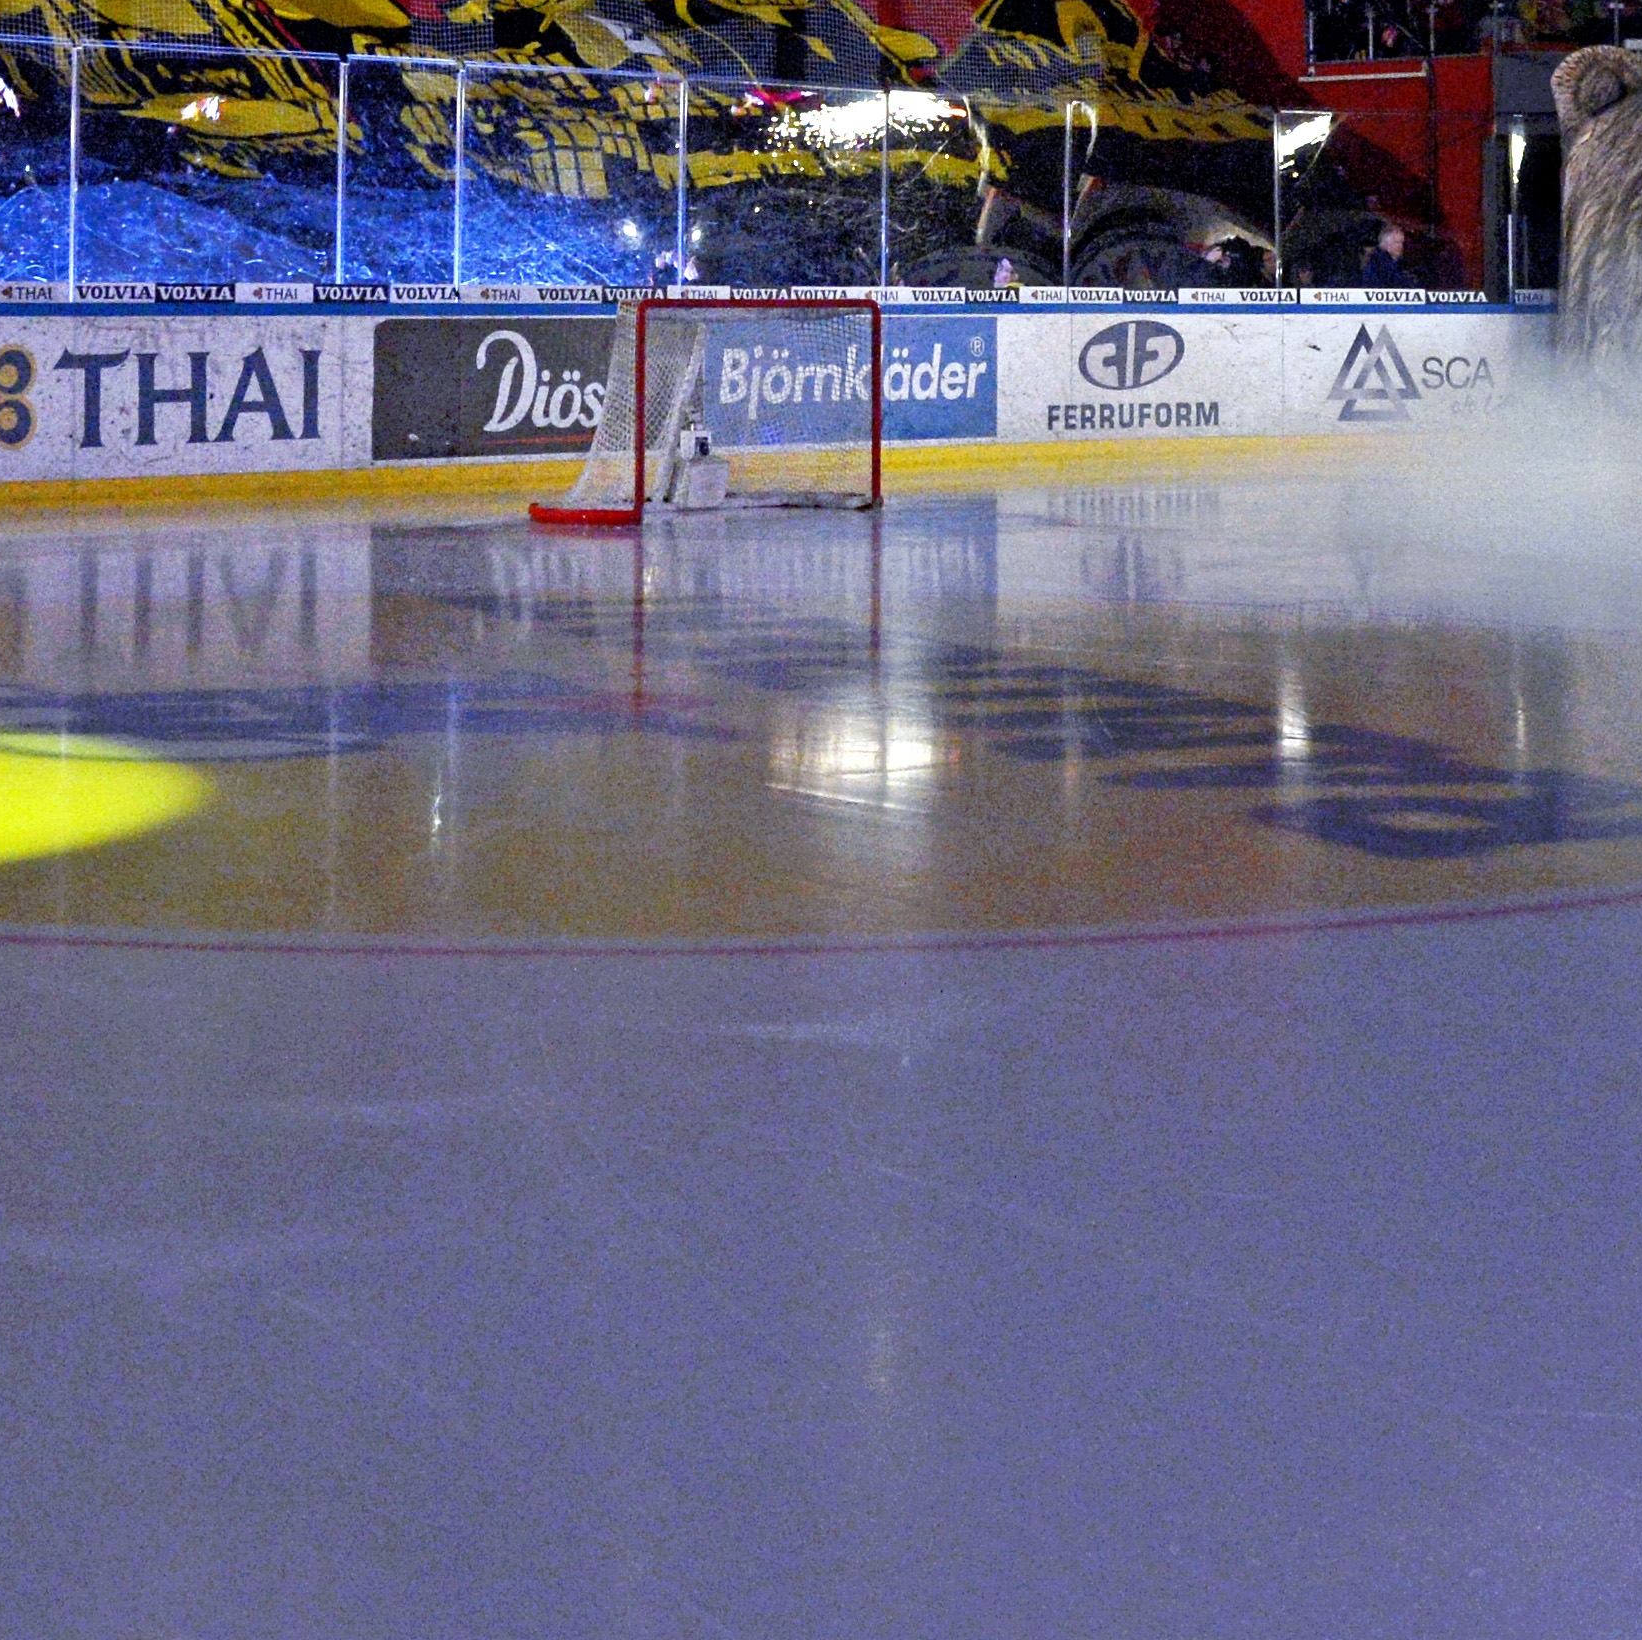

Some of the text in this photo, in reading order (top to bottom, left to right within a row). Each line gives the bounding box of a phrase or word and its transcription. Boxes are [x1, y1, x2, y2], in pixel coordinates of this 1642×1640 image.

[16, 286, 53, 300] THAI
[76, 285, 154, 300] VOLVIA
[160, 285, 235, 300] VOLVIA
[265, 287, 298, 300] THAI
[315, 286, 388, 300] VOLVIA
[394, 286, 459, 300] VOLVIA
[490, 289, 520, 301] THAI
[537, 288, 600, 301] VOLVIA
[607, 288, 667, 301] VOLVIA
[874, 290, 899, 301] THAI
[912, 290, 963, 302] VOLVIA
[966, 289, 1018, 302] VOLVIA
[1039, 290, 1062, 301] THAI
[1071, 290, 1122, 302] VOLVIA
[1124, 290, 1178, 302] VOLVIA
[1200, 292, 1225, 302] THAI
[1239, 291, 1295, 303] VOLVIA
[1323, 291, 1350, 302] THAI
[1365, 291, 1423, 303] VOLVIA
[1427, 291, 1488, 303] VOLVIA
[1420, 356, 1495, 389] SCA
[476, 329, 606, 433] Diös
[53, 345, 321, 449] THAI
[1047, 401, 1220, 432] FERRUFORM
